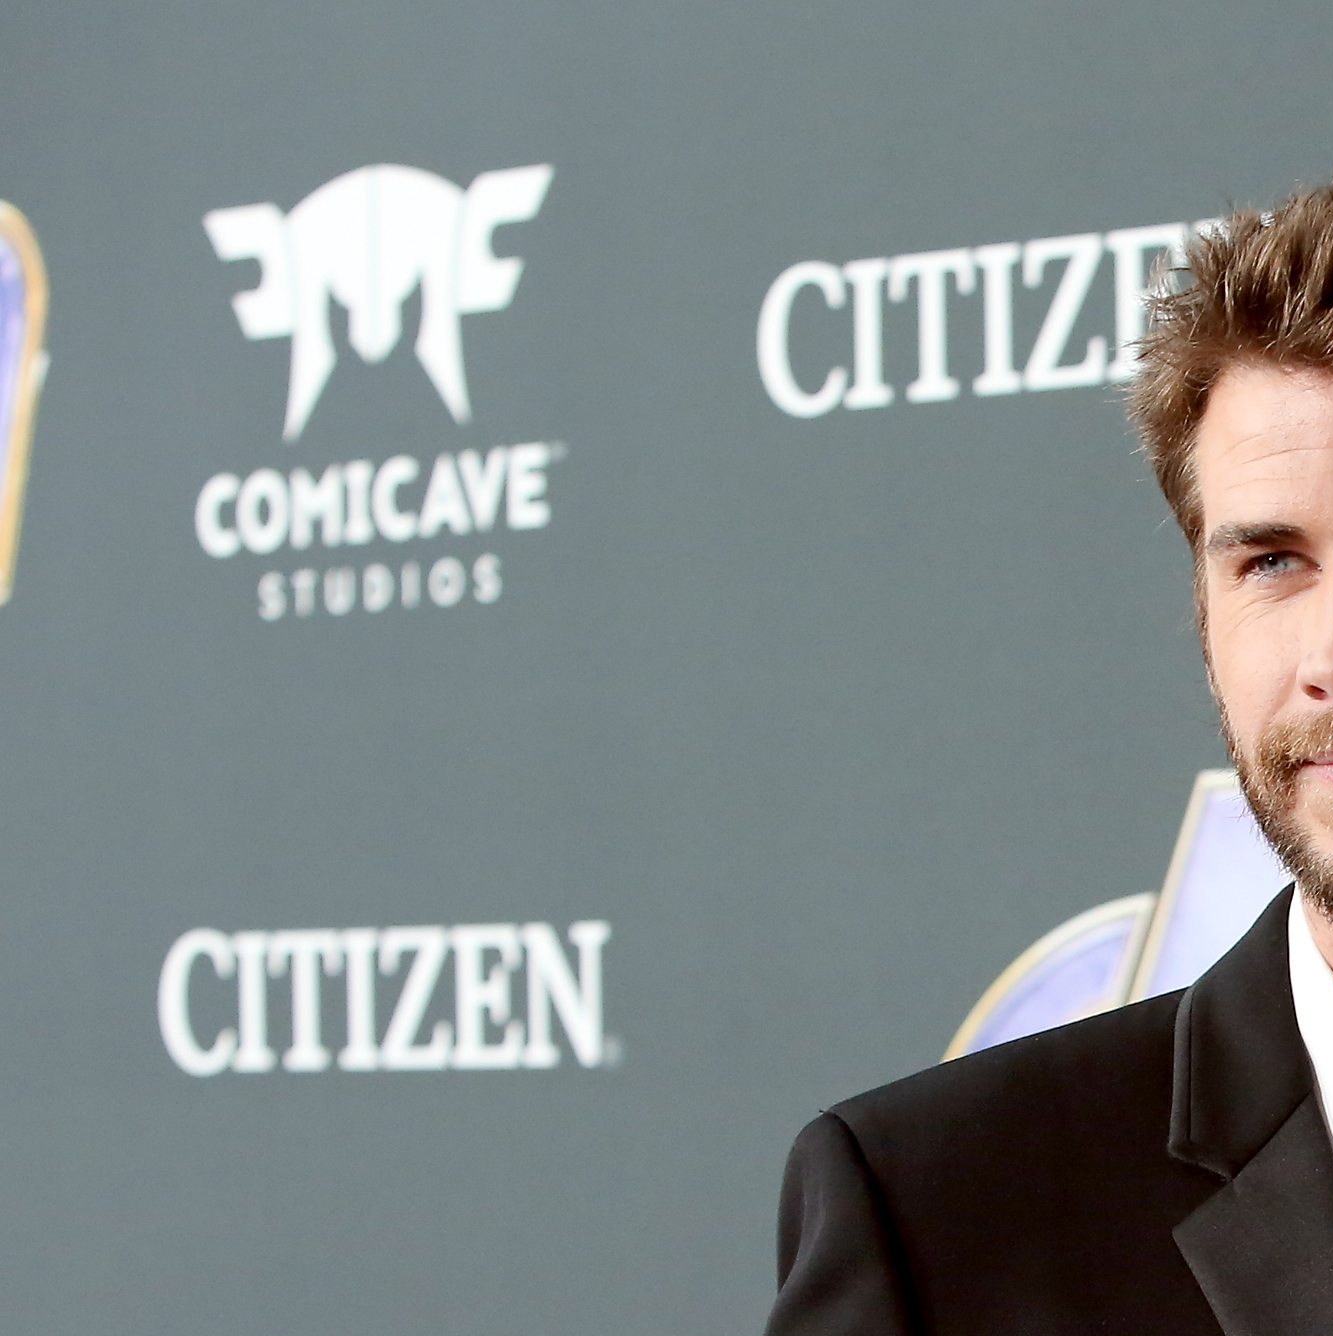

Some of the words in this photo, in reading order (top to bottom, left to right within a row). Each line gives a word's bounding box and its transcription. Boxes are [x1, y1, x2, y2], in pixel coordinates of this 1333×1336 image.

[756, 212, 1275, 419] CITIZE
[195, 442, 552, 558] COMICAVE
[257, 553, 502, 621] STUDIOS
[157, 919, 612, 1077] CITIZEN
